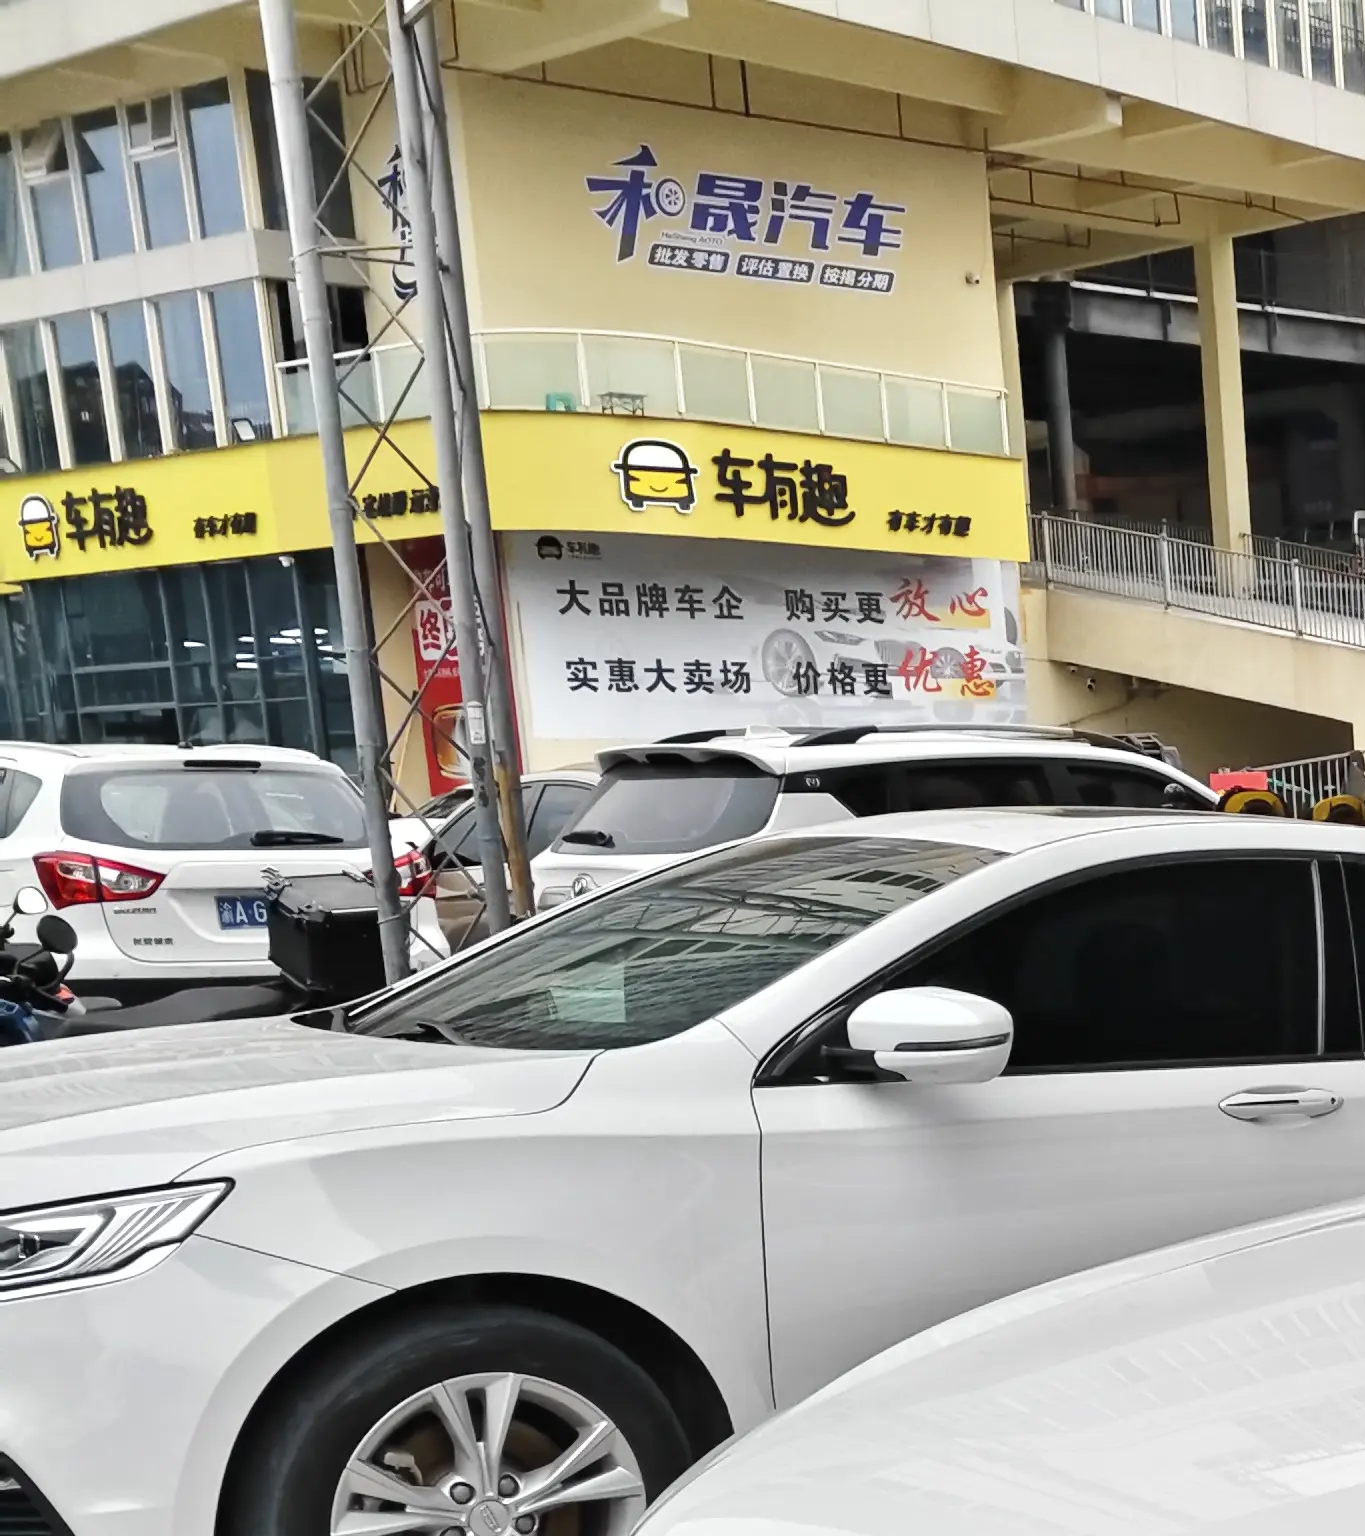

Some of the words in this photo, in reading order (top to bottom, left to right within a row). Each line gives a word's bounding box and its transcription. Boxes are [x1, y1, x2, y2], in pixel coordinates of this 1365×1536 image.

[585, 144, 906, 263] 和晟汽车
[653, 247, 727, 271] 批发零售
[740, 257, 811, 282] 评估置换
[822, 265, 890, 290] 按揭分期
[711, 448, 856, 526] 车有趣
[61, 485, 153, 551] 车有趣
[556, 579, 745, 620] 大品牌车企
[784, 577, 989, 624] 购买更放心
[565, 658, 752, 693] 实惠大卖场
[792, 645, 995, 700] 价格更优惠
